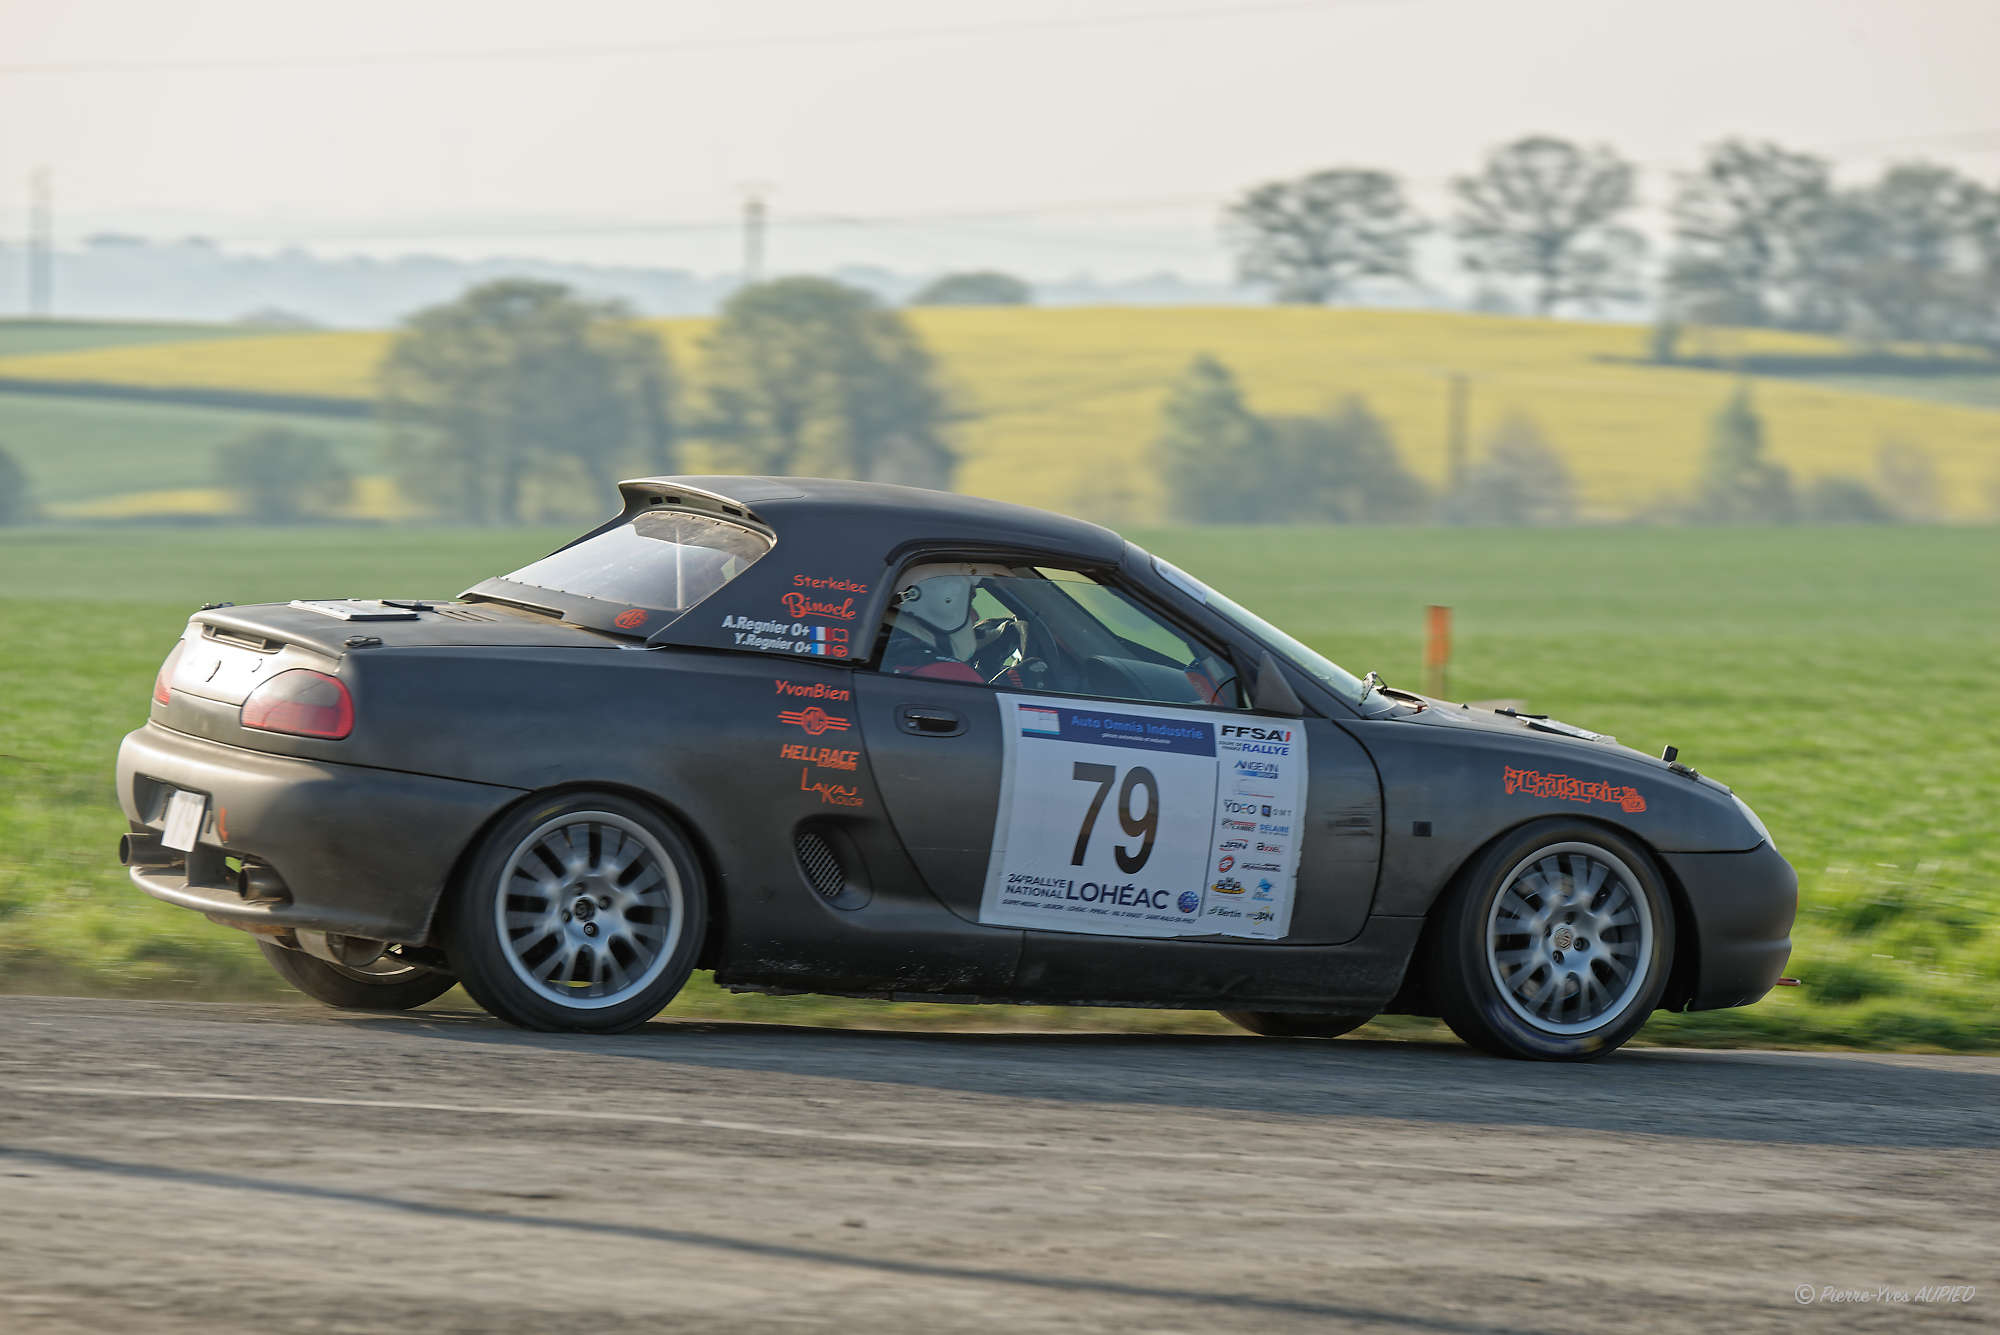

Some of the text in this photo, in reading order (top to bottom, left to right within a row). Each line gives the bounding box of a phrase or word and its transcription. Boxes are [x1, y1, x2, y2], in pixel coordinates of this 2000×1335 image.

[793, 574, 868, 594] Sterkelec
[781, 592, 856, 620] Binocle
[721, 615, 790, 635] A.Regnier
[734, 632, 793, 650] Y.Regnier
[775, 679, 850, 701] YvonBien
[1072, 715, 1100, 728] Auto
[1103, 719, 1144, 734] Omnia
[1147, 722, 1204, 739] Industrie
[1221, 725, 1283, 742] FFSA
[1242, 743, 1290, 756] RALLYE
[1071, 761, 1159, 875] 79
[1005, 884, 1064, 899] NATIONAL
[1066, 880, 1171, 910] LOHÉAC
